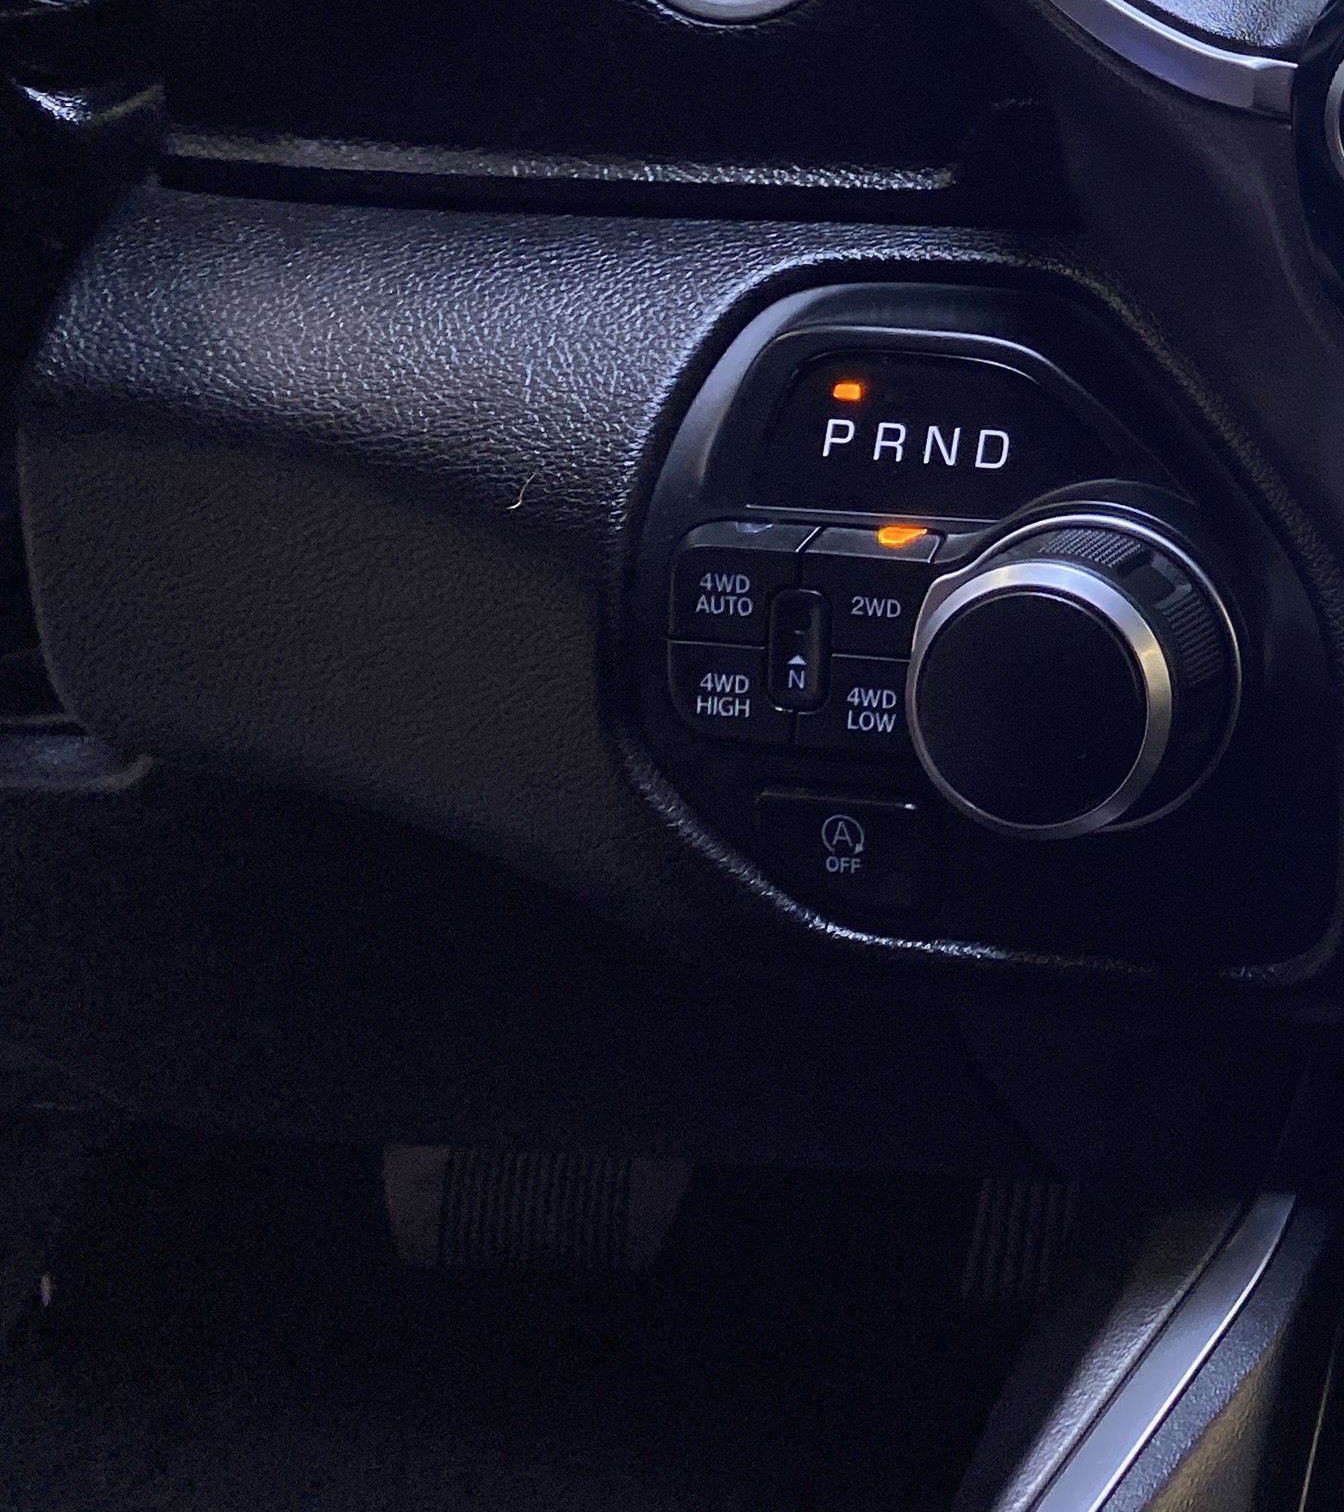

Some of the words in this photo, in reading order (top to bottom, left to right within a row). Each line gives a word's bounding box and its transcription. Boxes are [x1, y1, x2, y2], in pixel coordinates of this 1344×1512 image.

[822, 419, 856, 457] P
[873, 423, 906, 462] R
[923, 426, 959, 465] N
[975, 430, 1009, 469] D
[700, 573, 749, 595] 4WD
[696, 595, 753, 617] AUTO
[851, 596, 901, 618] 2WD
[700, 673, 749, 694] 4WD
[788, 669, 805, 689] N
[696, 695, 750, 718] HIGH
[846, 687, 897, 710] 4WD
[847, 710, 896, 733] LOW
[825, 856, 861, 874] OFF
